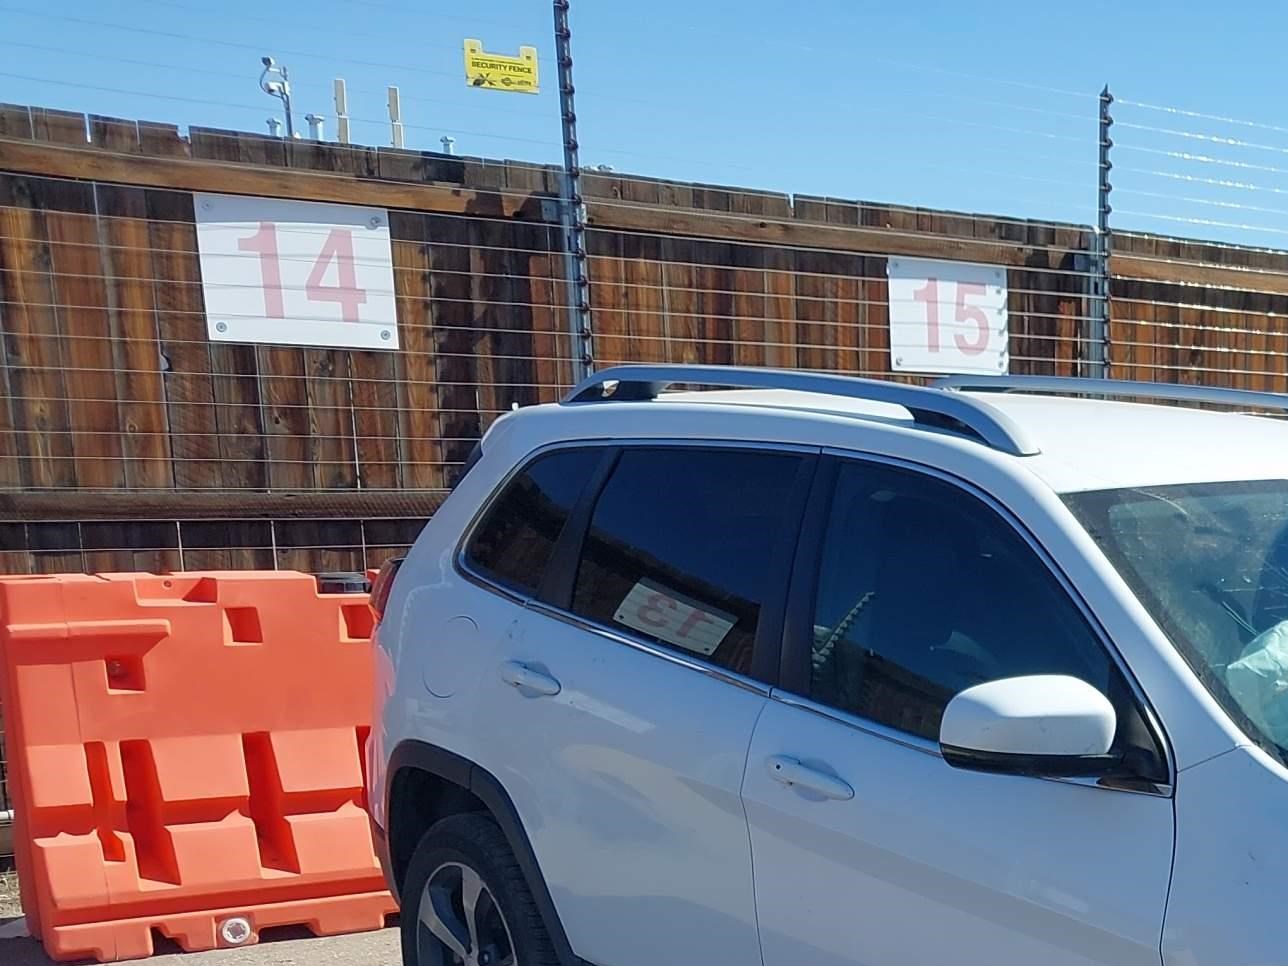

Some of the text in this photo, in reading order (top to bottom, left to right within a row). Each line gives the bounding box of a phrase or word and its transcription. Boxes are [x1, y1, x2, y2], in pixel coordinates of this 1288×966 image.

[471, 61, 508, 71] SECURITY
[508, 65, 532, 74] FENCE
[237, 220, 367, 322] 14
[913, 277, 989, 355] 15
